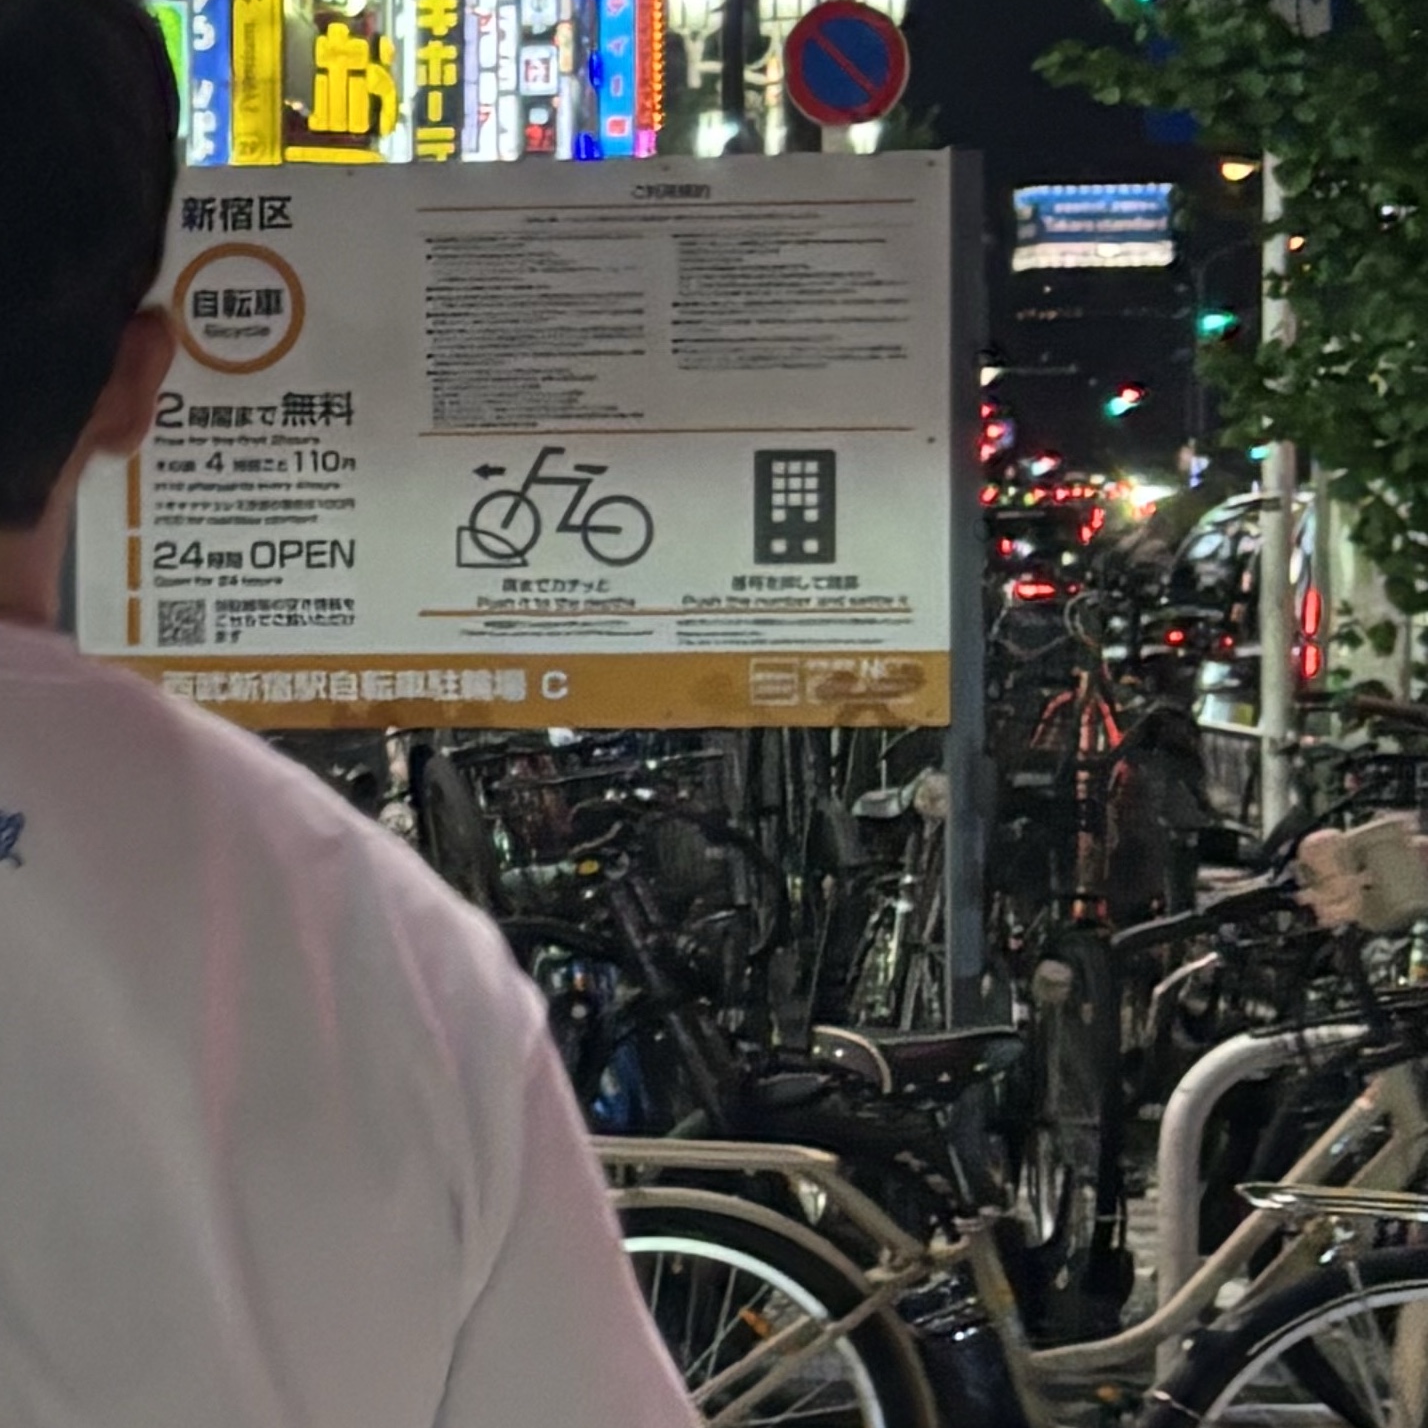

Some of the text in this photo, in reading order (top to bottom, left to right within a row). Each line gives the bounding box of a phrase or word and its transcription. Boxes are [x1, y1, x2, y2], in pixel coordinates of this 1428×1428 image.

[181, 195, 293, 231] 新宿区
[191, 288, 284, 319] 自転車
[155, 390, 355, 429] 2時間まで無料
[250, 539, 356, 569] OPEN
[541, 670, 569, 700] C
